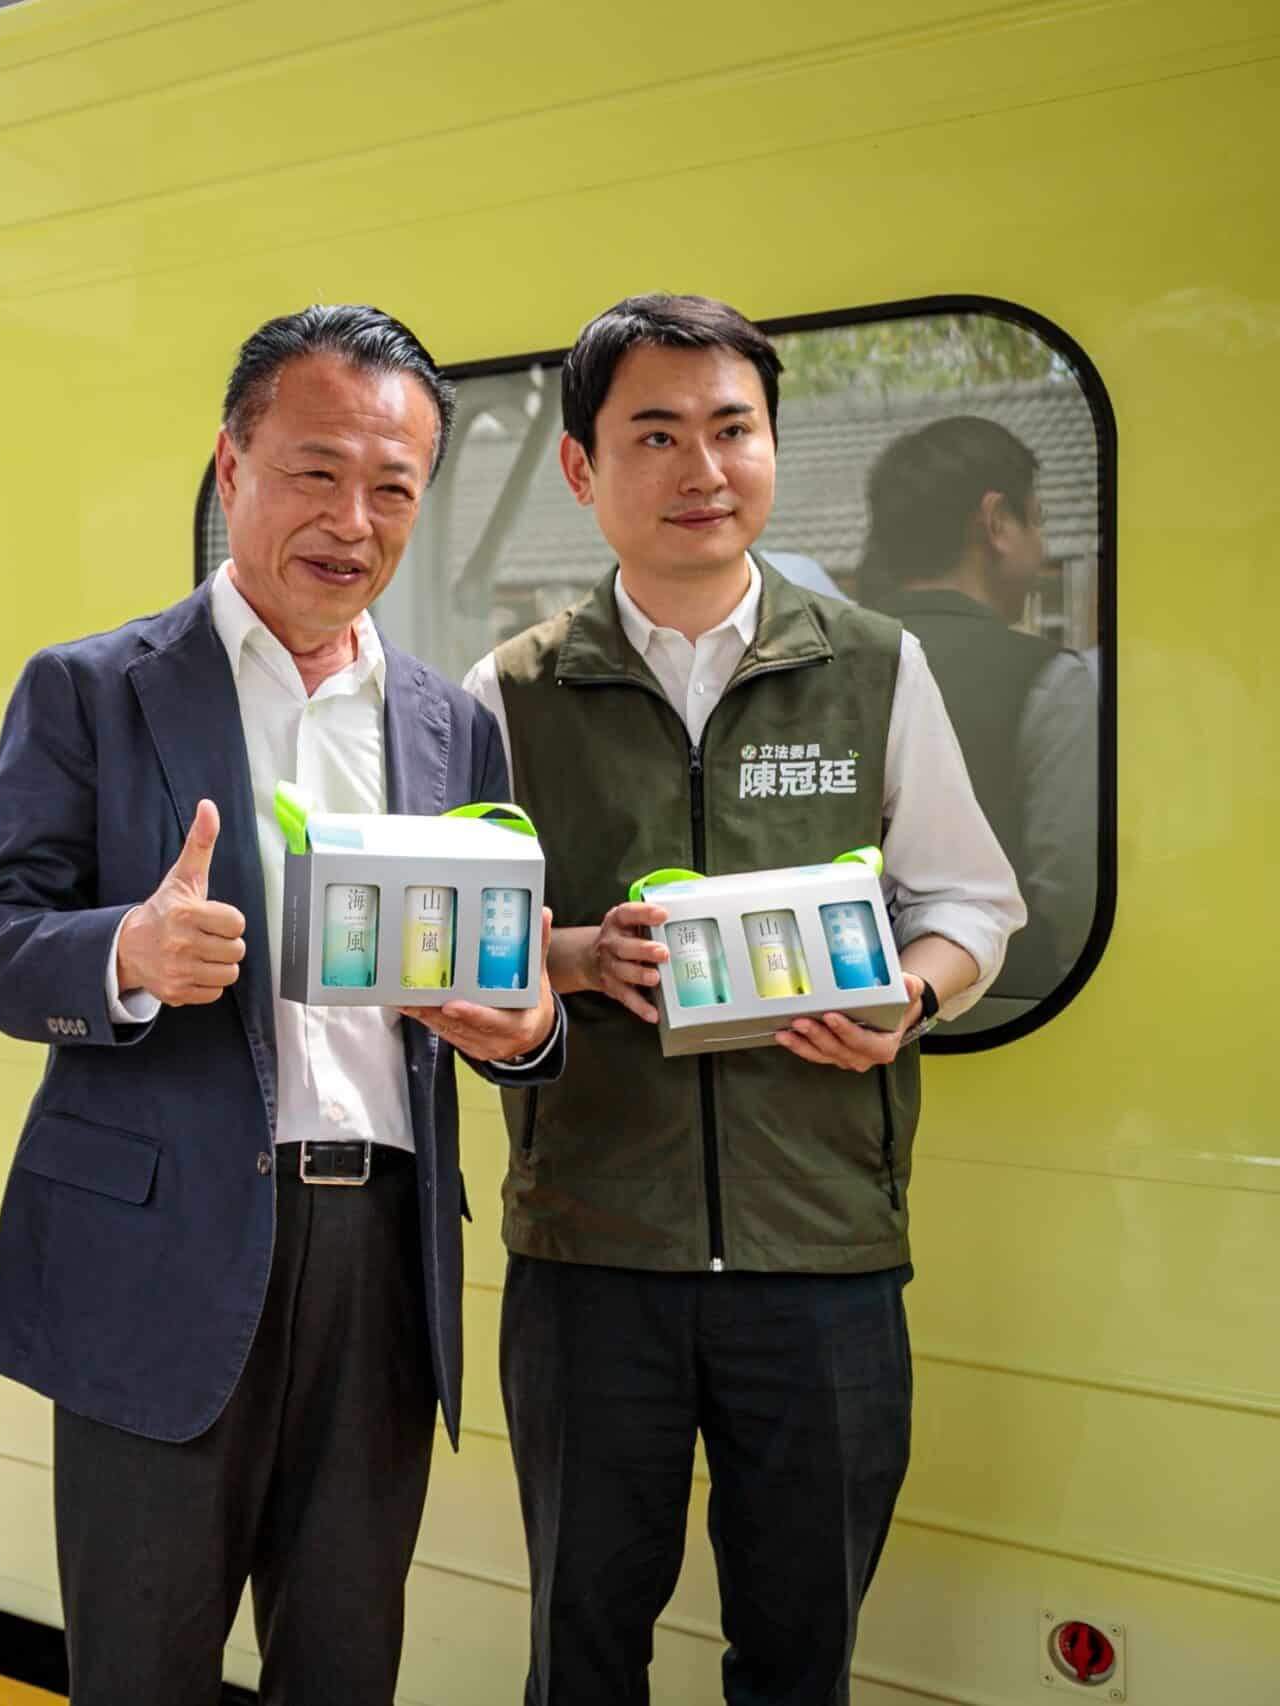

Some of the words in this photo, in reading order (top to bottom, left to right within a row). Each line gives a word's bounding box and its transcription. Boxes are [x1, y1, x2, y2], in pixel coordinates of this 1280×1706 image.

[758, 744, 821, 760] 立法委員
[740, 760, 857, 799] 陳冠廷
